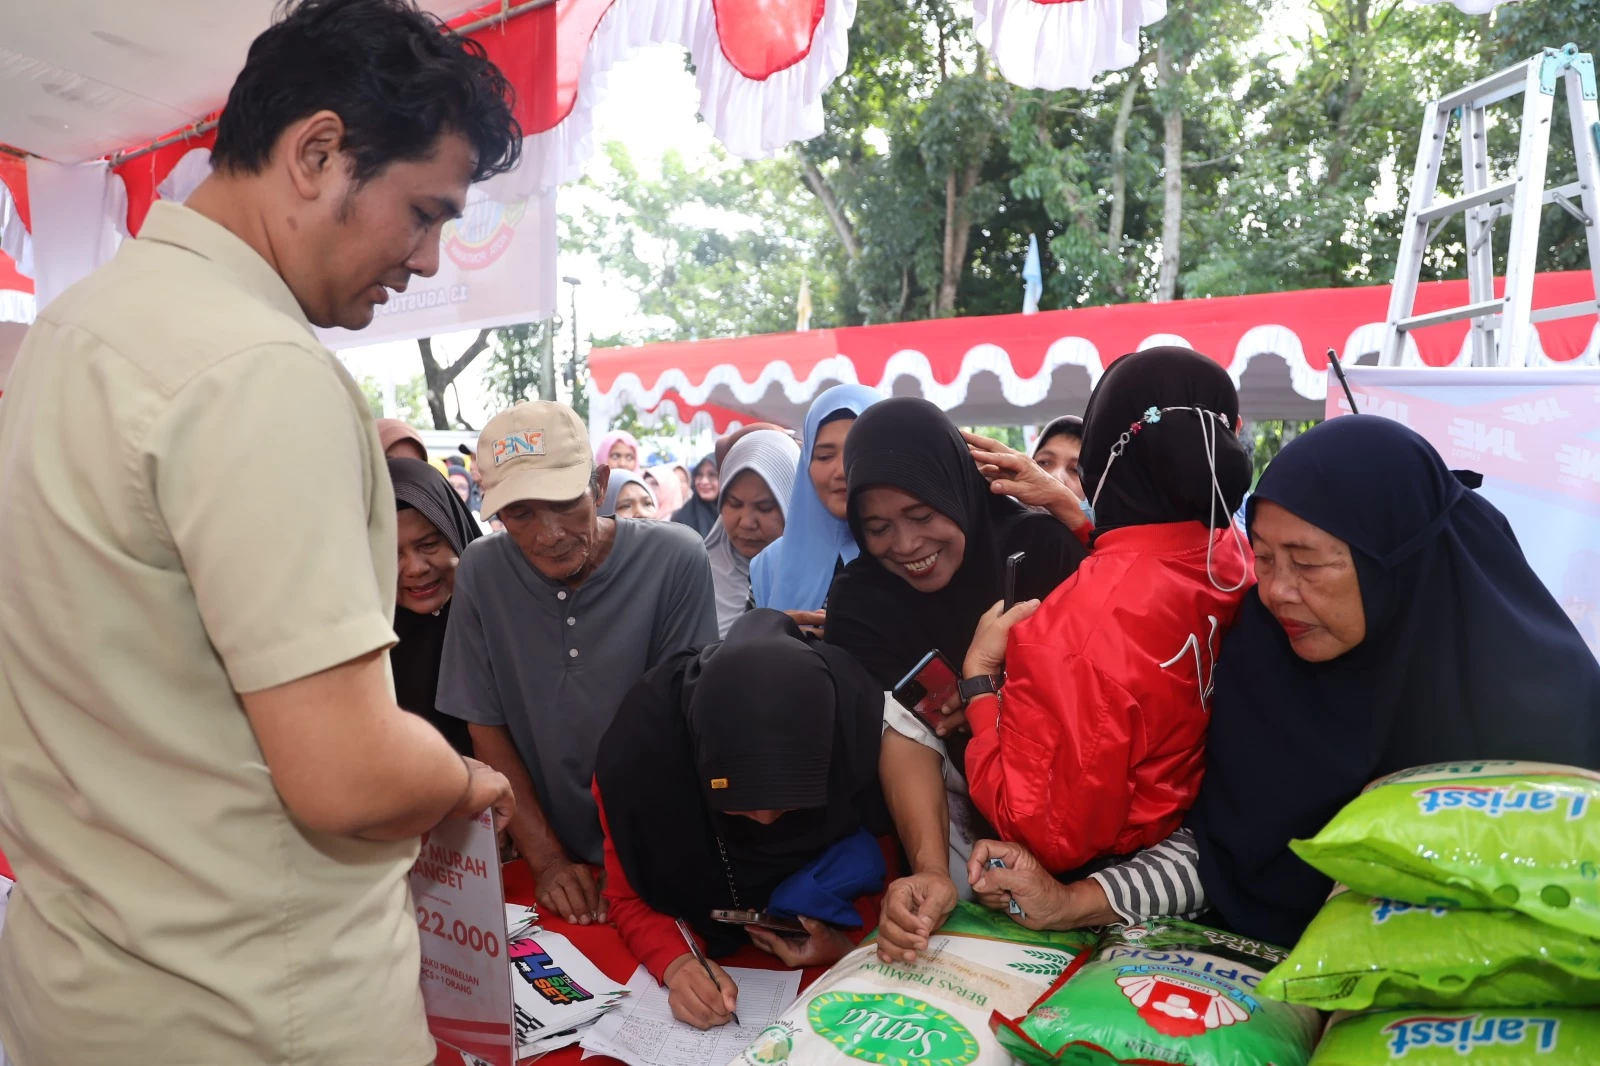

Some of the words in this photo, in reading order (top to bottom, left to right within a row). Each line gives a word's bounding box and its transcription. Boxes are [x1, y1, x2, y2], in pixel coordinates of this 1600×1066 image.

[1421, 790, 1587, 818] Larisst
[430, 844, 488, 879] MURAH
[1108, 949, 1195, 967] KOKI
[1206, 936, 1286, 963] ETRA
[440, 963, 480, 986] PEMBELIAN
[859, 963, 934, 987] PREMIUM
[1160, 976, 1185, 987] KOKI
[1202, 961, 1262, 989] OPI
[445, 978, 473, 996] ORANG
[533, 979, 571, 1003] SET
[548, 976, 583, 999] SAT
[937, 978, 988, 1007] BERAS
[1187, 982, 1211, 994] TOPI
[836, 1007, 947, 1058] Sania
[1391, 1017, 1558, 1055] Larisst
